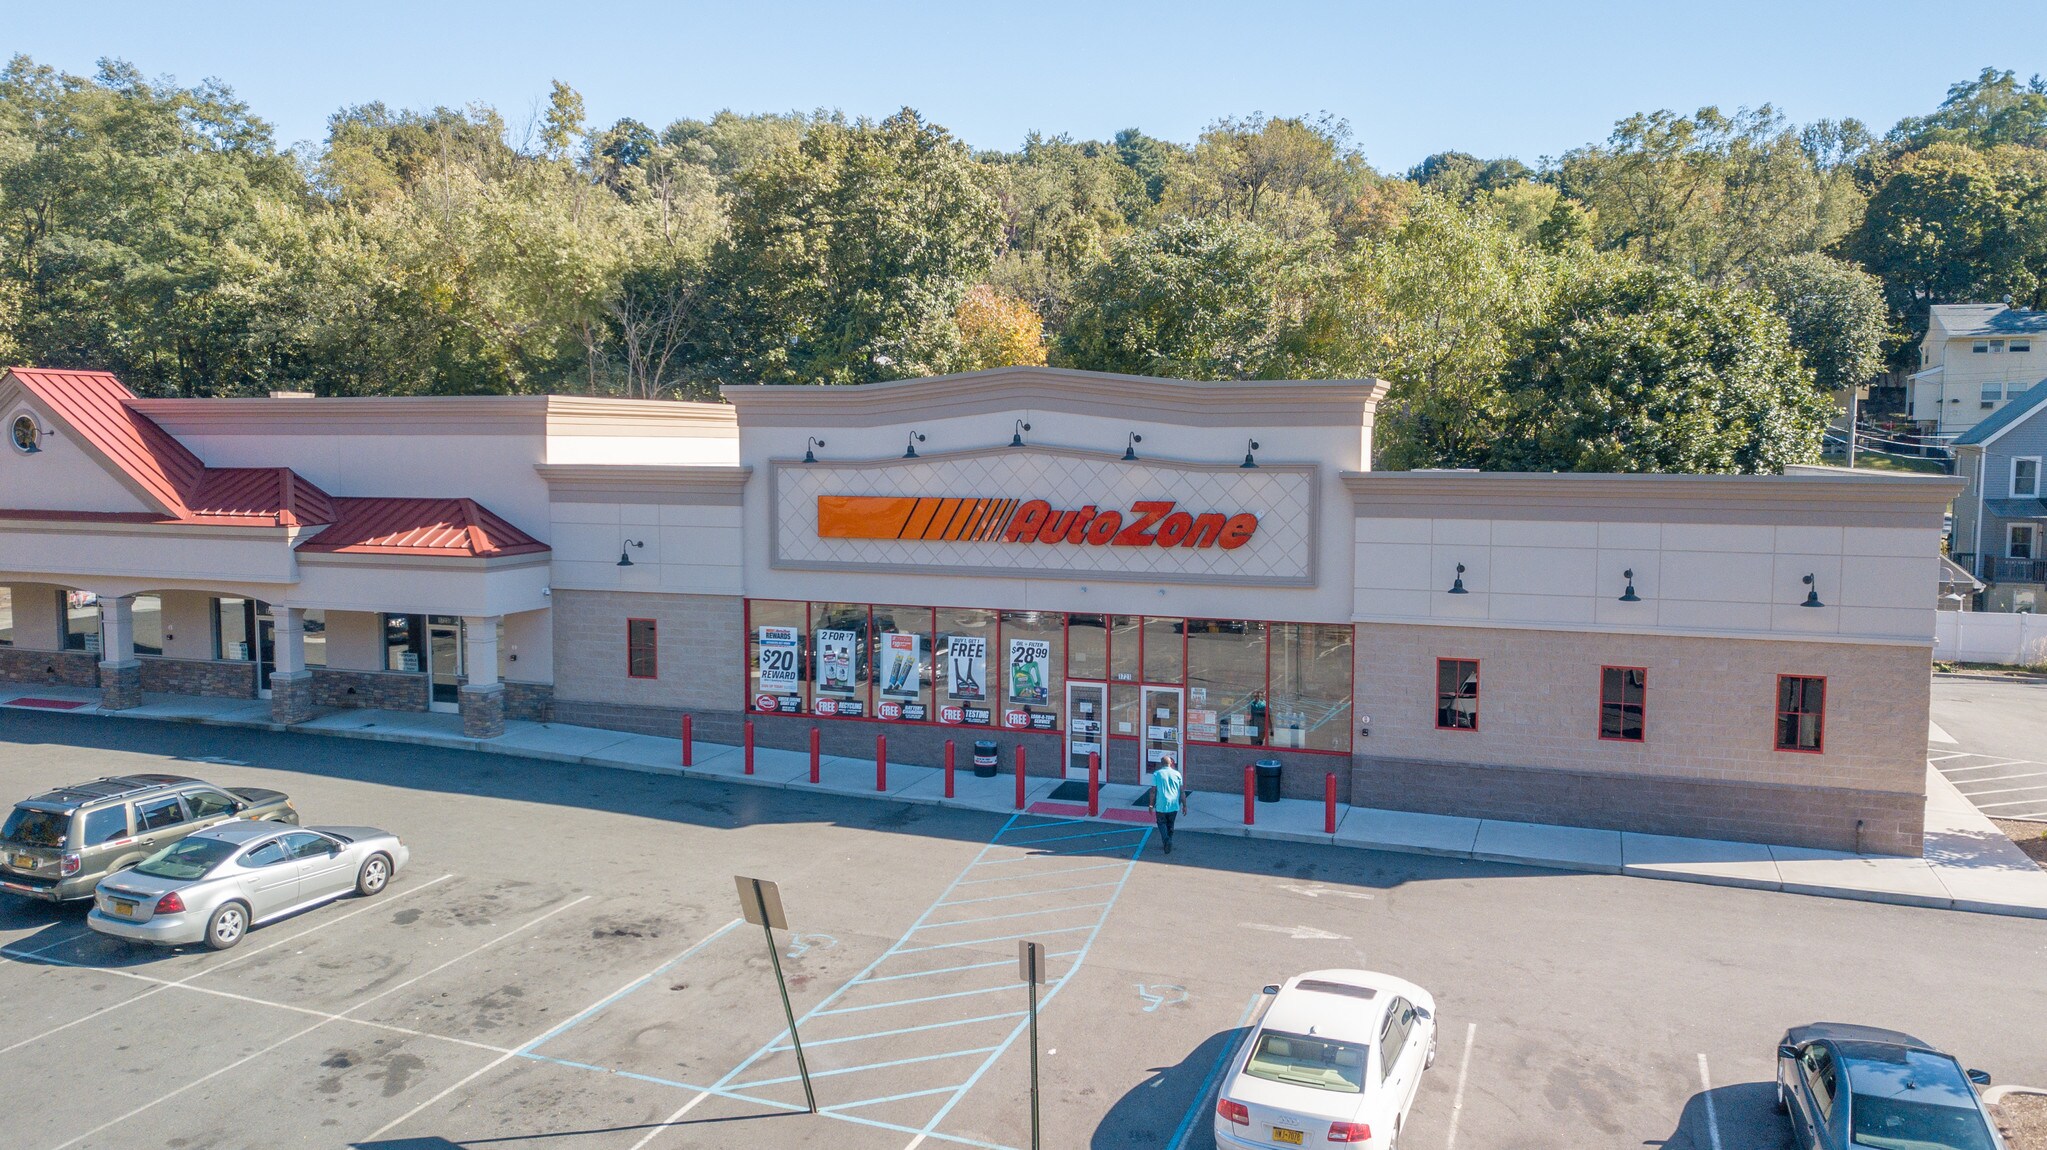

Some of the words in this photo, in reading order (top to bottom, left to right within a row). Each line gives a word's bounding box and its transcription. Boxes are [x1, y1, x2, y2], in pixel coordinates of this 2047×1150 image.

[1002, 499, 1259, 549] AutoZone
[766, 632, 791, 640] REWARDS
[822, 632, 827, 640] 2
[828, 632, 845, 640] FOR
[846, 633, 854, 641] $7
[950, 643, 984, 658] FREE
[762, 648, 794, 671] $20
[762, 670, 796, 680] REWARD
[818, 702, 835, 712] FREE
[838, 702, 862, 710] RECYCLING
[881, 704, 898, 716] FREE
[944, 709, 961, 720] FREE
[965, 710, 989, 719] TESTING
[1009, 713, 1026, 725] FREE
